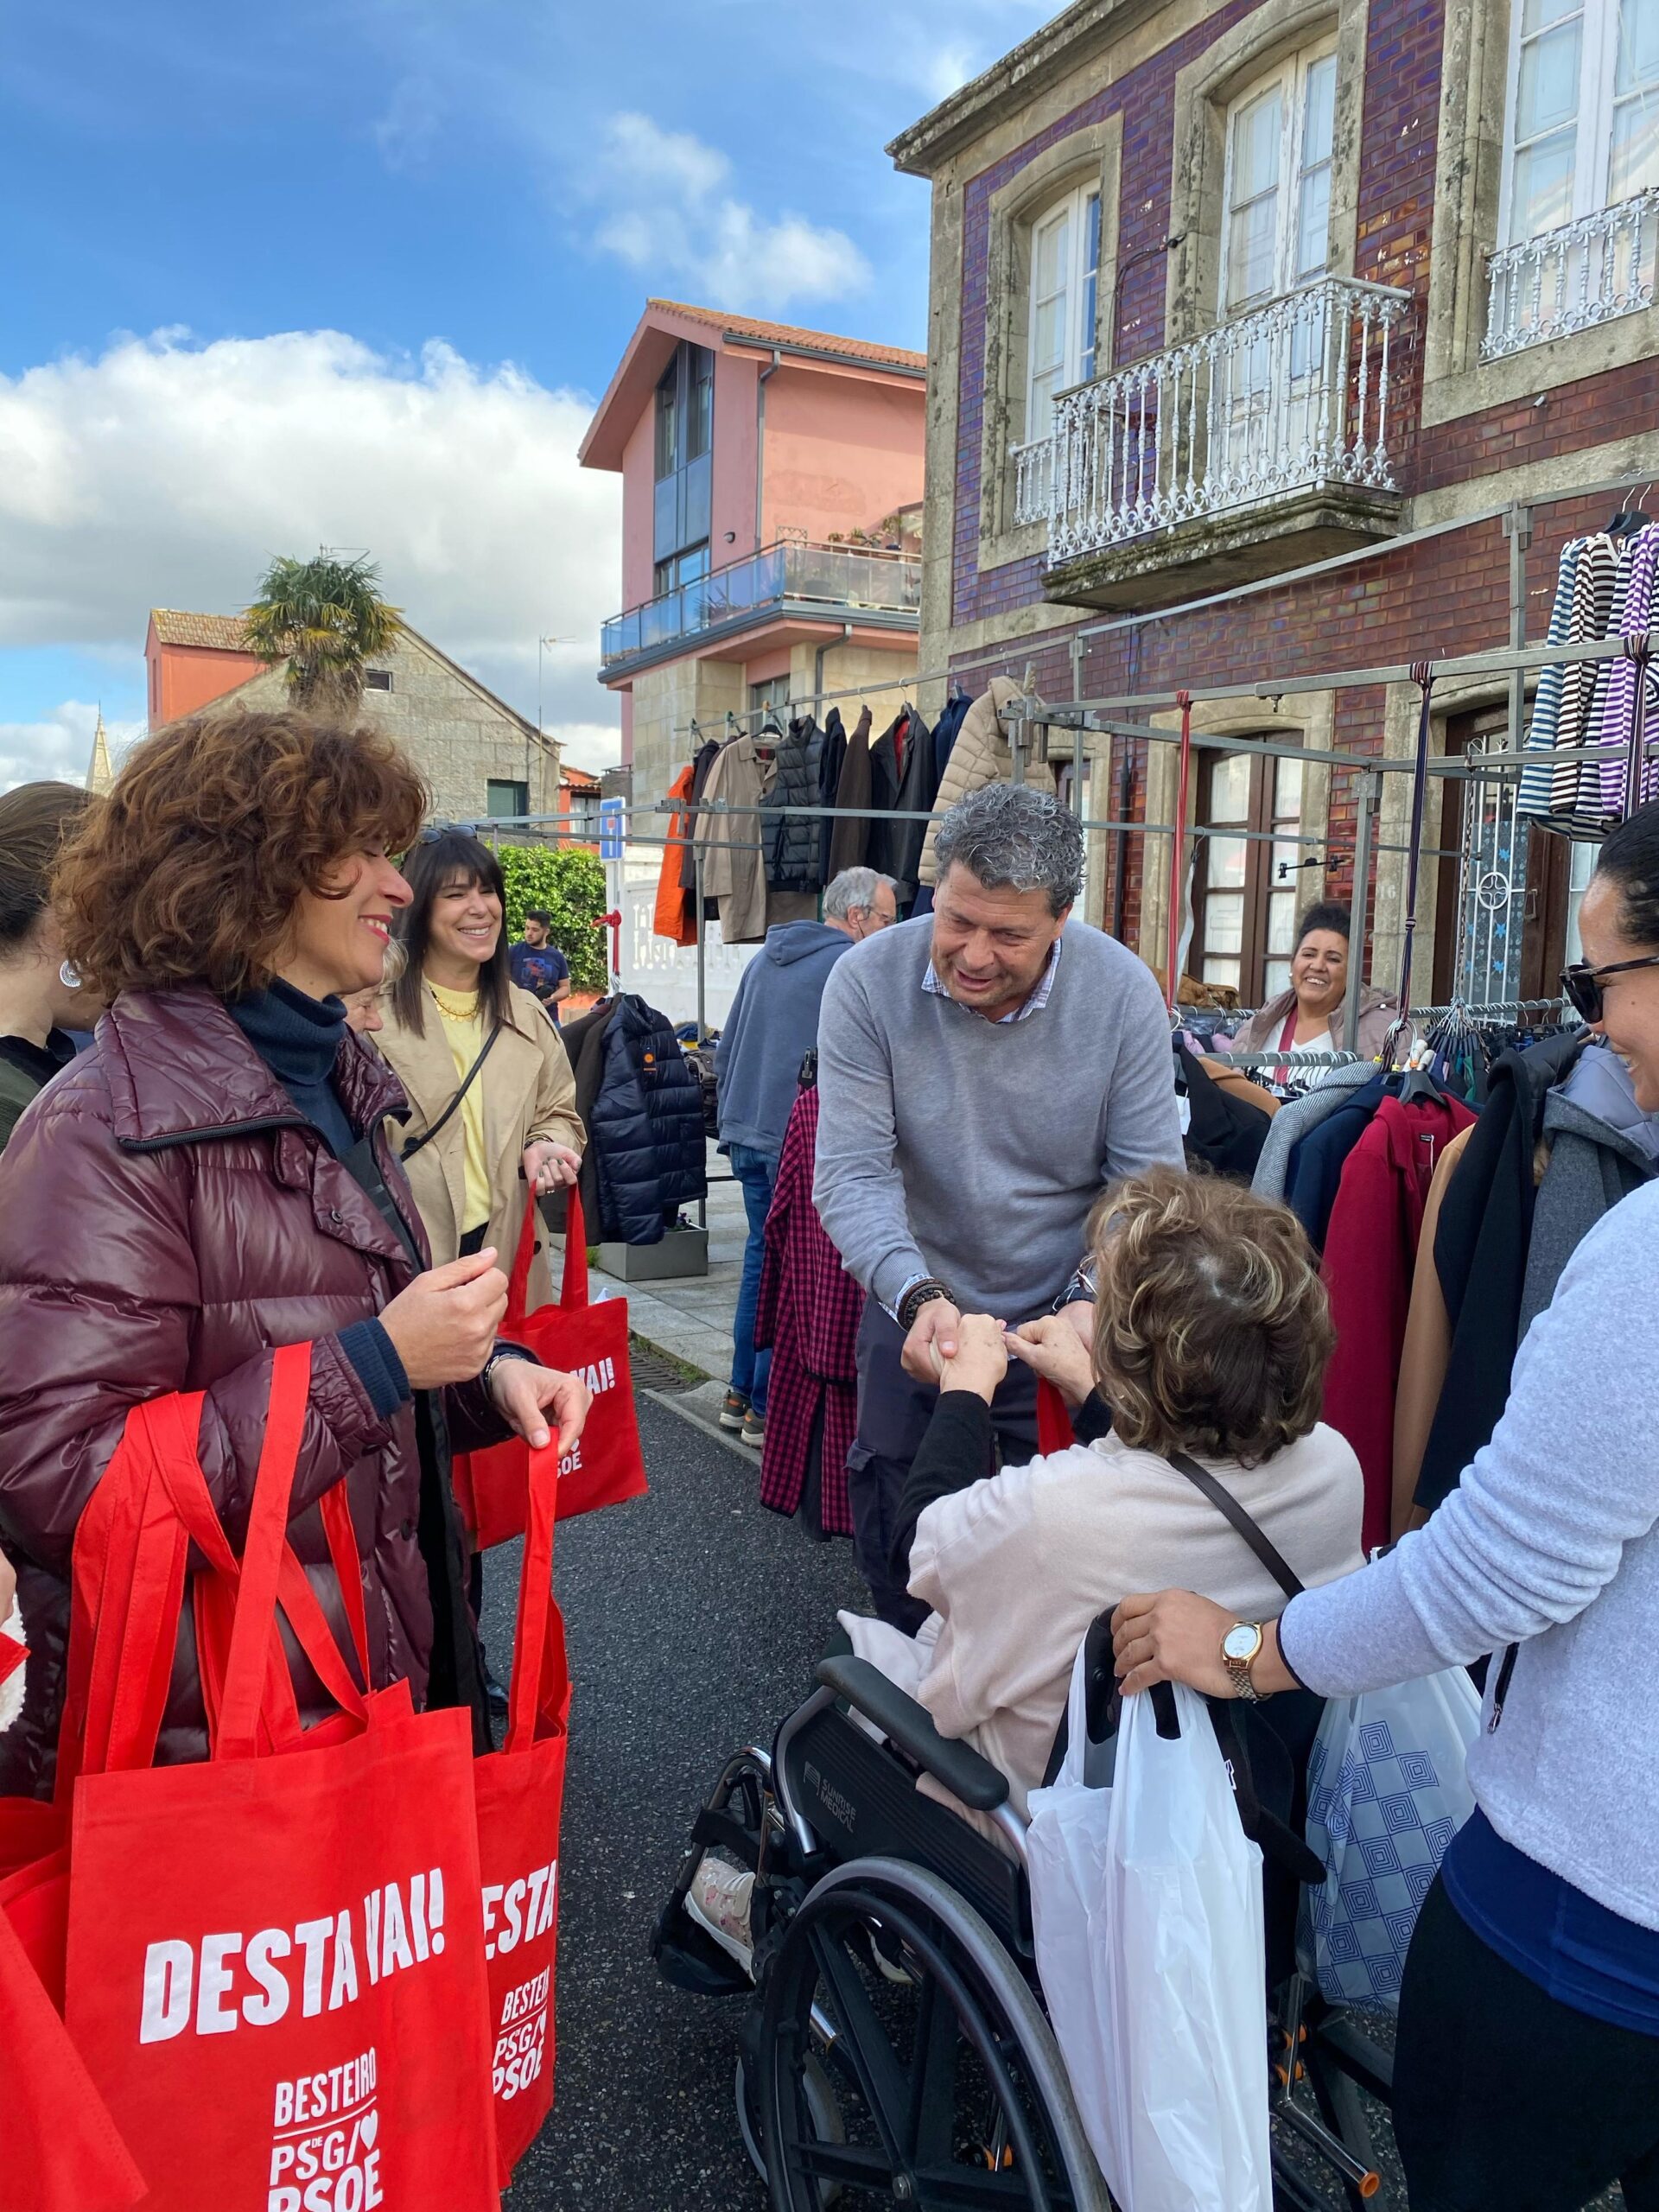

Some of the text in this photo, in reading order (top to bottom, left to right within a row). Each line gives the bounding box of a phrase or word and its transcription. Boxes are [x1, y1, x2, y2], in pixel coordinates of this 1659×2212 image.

[820, 1789, 854, 1834] MEDICAL
[822, 1778, 856, 1821] SUNRISE
[140, 1867, 444, 2044] DESTA VAI!
[274, 2046, 377, 2128] BESTEIRO
